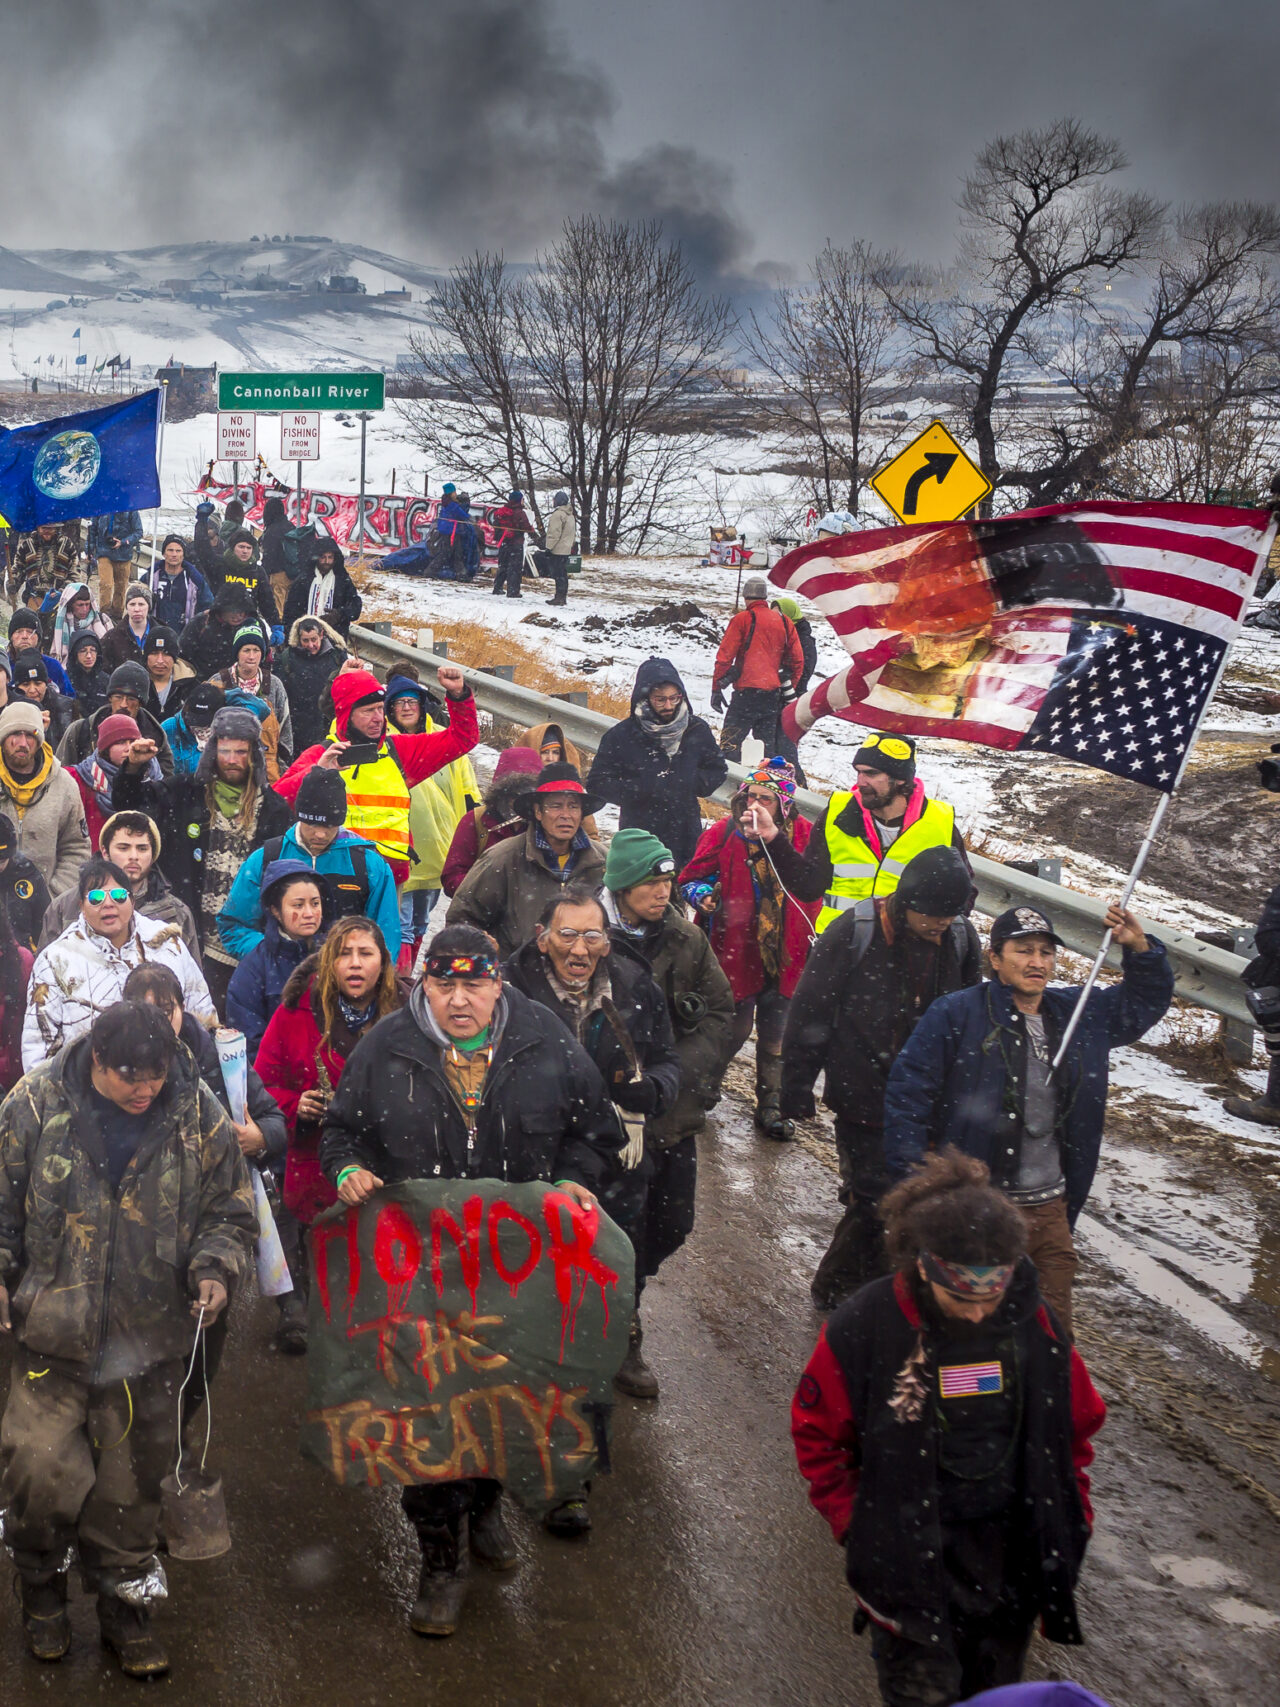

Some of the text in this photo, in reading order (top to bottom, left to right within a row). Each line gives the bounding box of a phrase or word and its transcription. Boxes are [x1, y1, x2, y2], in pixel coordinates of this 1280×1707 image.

[233, 385, 370, 398] Cannonball River
[230, 416, 243, 426] NO
[294, 416, 307, 426] NO
[222, 429, 251, 438] DIVING
[283, 428, 318, 438] FISHING
[227, 440, 245, 448] FROM
[291, 440, 309, 448] FROM
[225, 450, 248, 458] BRIDGE
[289, 450, 311, 458] BRIDGE
[346, 1309, 509, 1394] THE
